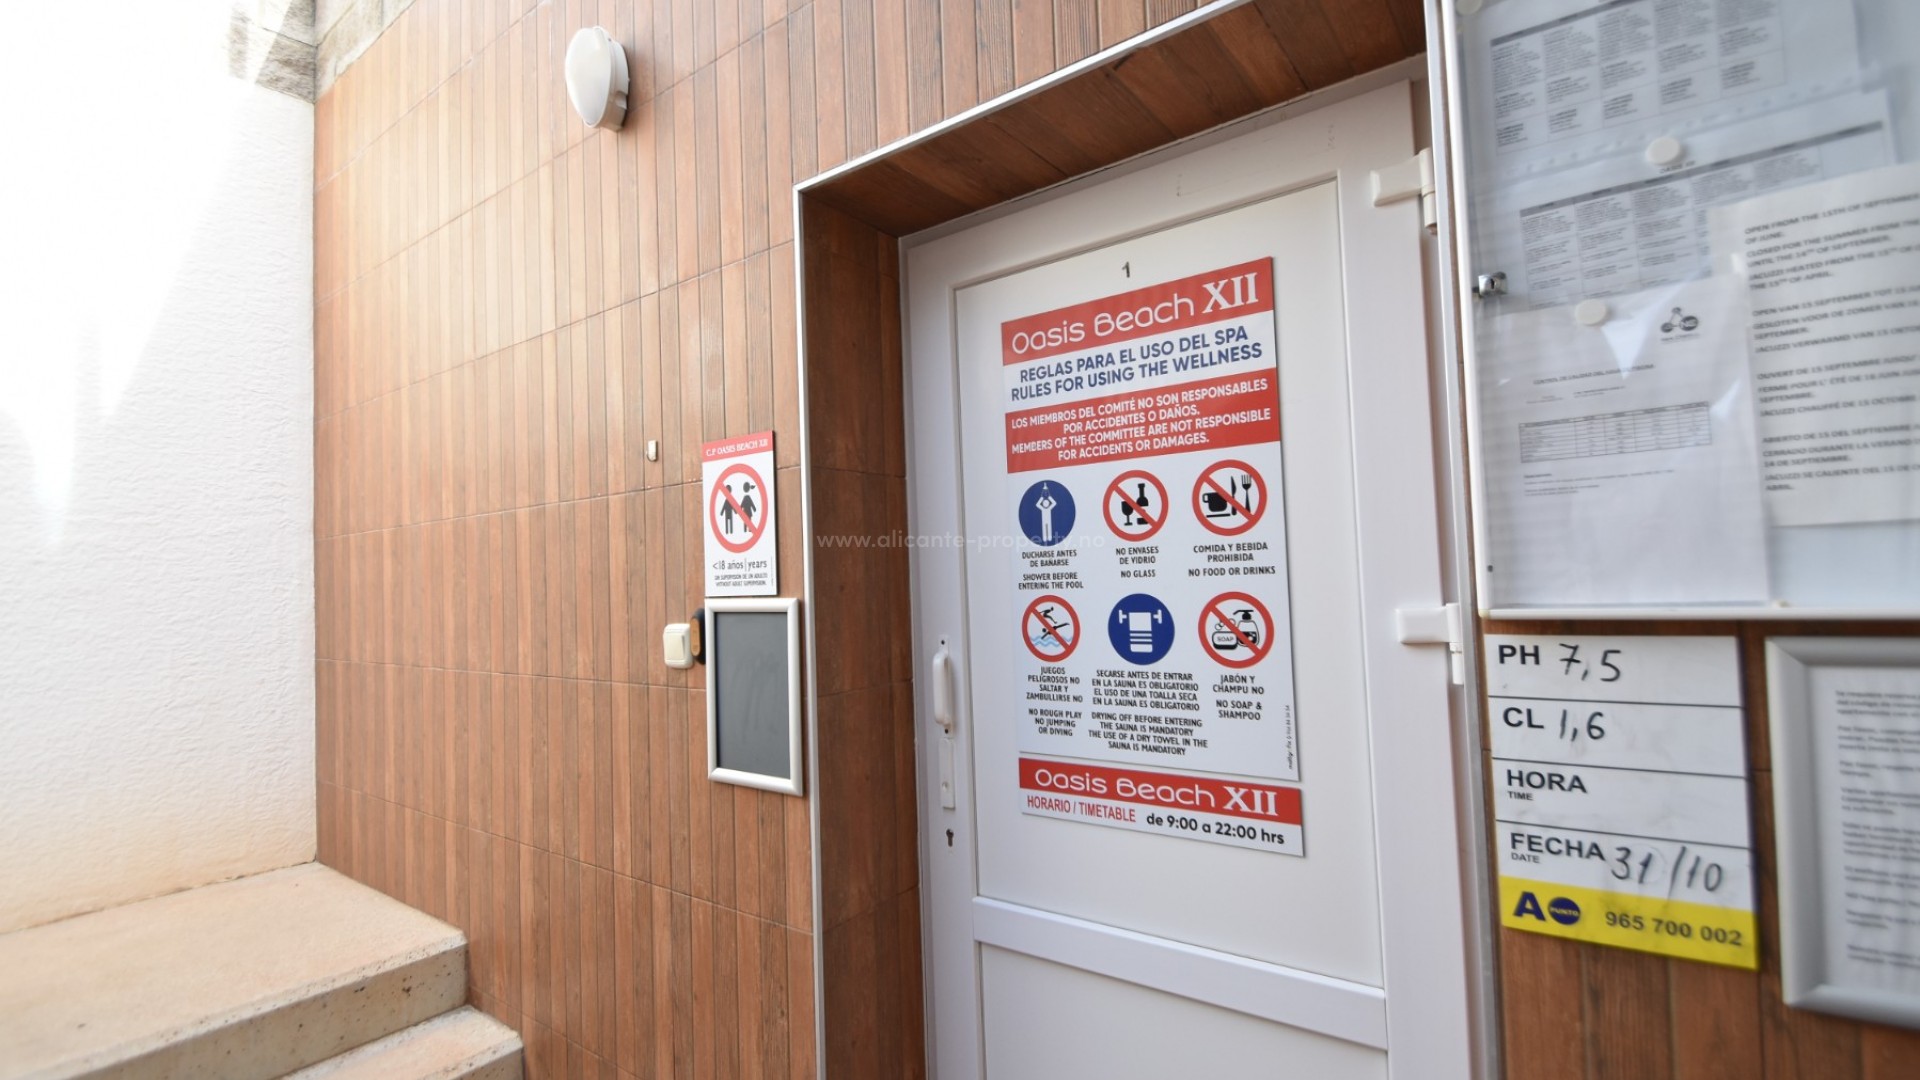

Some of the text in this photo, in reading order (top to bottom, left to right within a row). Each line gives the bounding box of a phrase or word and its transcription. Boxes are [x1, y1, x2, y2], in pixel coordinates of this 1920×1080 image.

[1122, 262, 1131, 278] 1
[1012, 272, 1258, 354] Oasis Beach XII
[1020, 326, 1248, 383] REGLAS PARA EL USO DEL SPA
[1011, 343, 1262, 401] RULES FOR USING THE WELLNESS
[1011, 378, 1268, 429] LOS MIEMBROS DEL COMITÉ NO SON RESPONSABLES
[1063, 402, 1200, 434] POR ACCIDENTES O DAÑOS.
[1012, 408, 1271, 455] MEMBERS OF THE COMMITTEE ARE NOT RESPONSIBLE
[1058, 433, 1209, 461] FOR ACCIDENTS OR DAMAGES.
[1128, 546, 1159, 555] ENVASES
[1194, 542, 1268, 553] COMIDA Y BEBIDA
[1022, 551, 1054, 559] DUCHARSE
[1132, 556, 1156, 564] VIDRIO
[1208, 553, 1253, 562] PROHIBIDA
[1023, 572, 1078, 581] SHOWER BEFORE
[1134, 569, 1155, 577] GLASS
[1203, 568, 1225, 576] FOOD
[1229, 567, 1240, 575] OR
[1243, 566, 1275, 575] DRINKS
[1019, 582, 1049, 590] ENTERING
[1066, 581, 1084, 589] POOL
[1498, 645, 1540, 665] PH
[1559, 643, 1621, 682] 7,5
[1041, 666, 1065, 674] JUEGOS
[1097, 670, 1125, 678] SECARSE
[1128, 671, 1149, 679] ANTES
[1164, 672, 1193, 680] ENTRAR
[1028, 675, 1068, 683] PELIGROSOS
[1103, 679, 1112, 687] LA
[1114, 680, 1136, 688] SAUNA
[1149, 681, 1198, 692] OBLIGATORIO
[1026, 692, 1070, 702] ZAMBULLIRSE
[1094, 688, 1102, 696] EL
[1149, 691, 1177, 700] TOALLA
[1179, 692, 1197, 701] SECA
[1115, 699, 1137, 707] SAUNA
[1150, 701, 1200, 711] OBLIGATORIO
[1216, 700, 1262, 710] NO SOAP &
[1040, 709, 1063, 717] ROUGH
[1066, 711, 1082, 719] PLAY
[1092, 712, 1116, 721] DRYING
[1135, 715, 1162, 724] BEFORE
[1165, 718, 1202, 727] ENTERING
[1219, 710, 1260, 720] SHAMPOO
[1502, 707, 1544, 729] CL
[1046, 719, 1076, 727] JUMPING
[1100, 722, 1113, 730] THE
[1116, 723, 1138, 731] SAUNA
[1149, 726, 1193, 736] MANDATORY
[1559, 709, 1605, 742] 1,6
[1050, 728, 1073, 736] DIVING
[1088, 730, 1101, 738] THE
[1104, 731, 1116, 739] USE
[1137, 734, 1150, 742] DRY
[1154, 736, 1180, 745] TOWEL
[1193, 739, 1208, 748] THE
[1109, 741, 1130, 750] SAUNA
[1142, 745, 1186, 755] MANDATORY
[1506, 770, 1587, 793] HORA
[1035, 769, 1278, 816] Oasis Beach XII
[1508, 791, 1533, 801] TIME
[1028, 795, 1070, 813] HORARIO
[1079, 802, 1136, 822] TIMETABLE
[1147, 813, 1163, 825] de
[1167, 816, 1197, 831] 9:00
[1202, 821, 1211, 832] a
[1216, 822, 1256, 839] 22:00
[1261, 827, 1284, 844] hrs
[1510, 833, 1605, 861] FECHA
[1511, 852, 1540, 864] DATE
[1513, 891, 1579, 921] A PUNTO
[1605, 911, 1743, 946] 965 700 002
